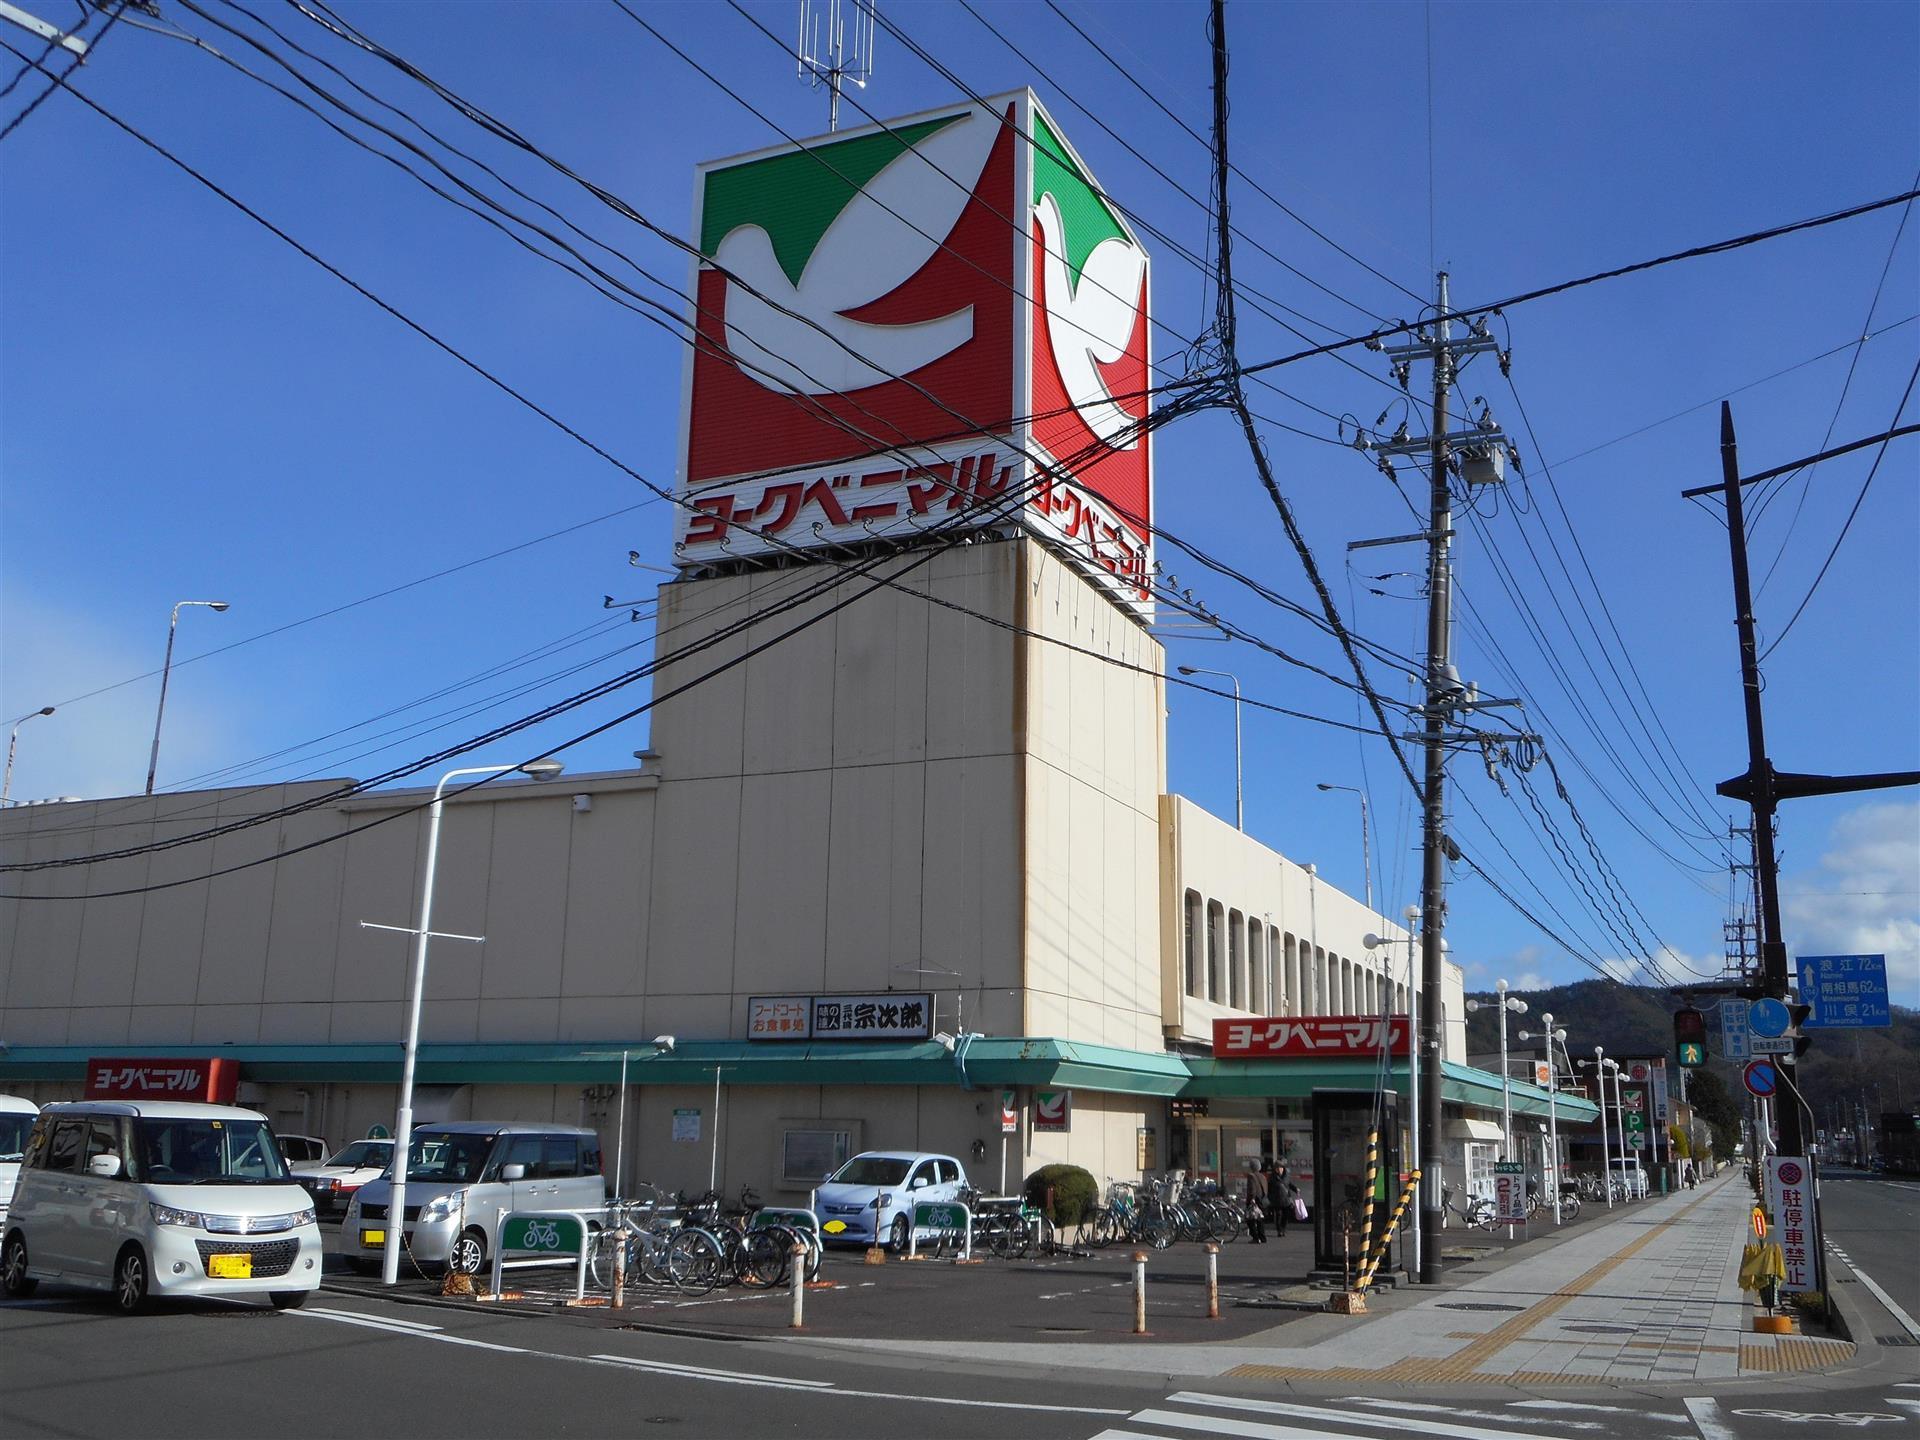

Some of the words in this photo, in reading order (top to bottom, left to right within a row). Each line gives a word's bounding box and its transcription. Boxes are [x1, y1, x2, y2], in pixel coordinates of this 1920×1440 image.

[686, 453, 1012, 544] ヨークベニマル
[1030, 464, 1151, 601] ヨークベニマル
[754, 1003, 805, 1017] フードコート
[854, 1002, 923, 1029] 宗次郎
[753, 1018, 805, 1033] お食事処
[1226, 1022, 1401, 1049] ヨークベニマル
[94, 1068, 201, 1091] ヨークベニマル
[1629, 1114, 1640, 1129] P
[1782, 1188, 1807, 1287] 駐停車禁止
